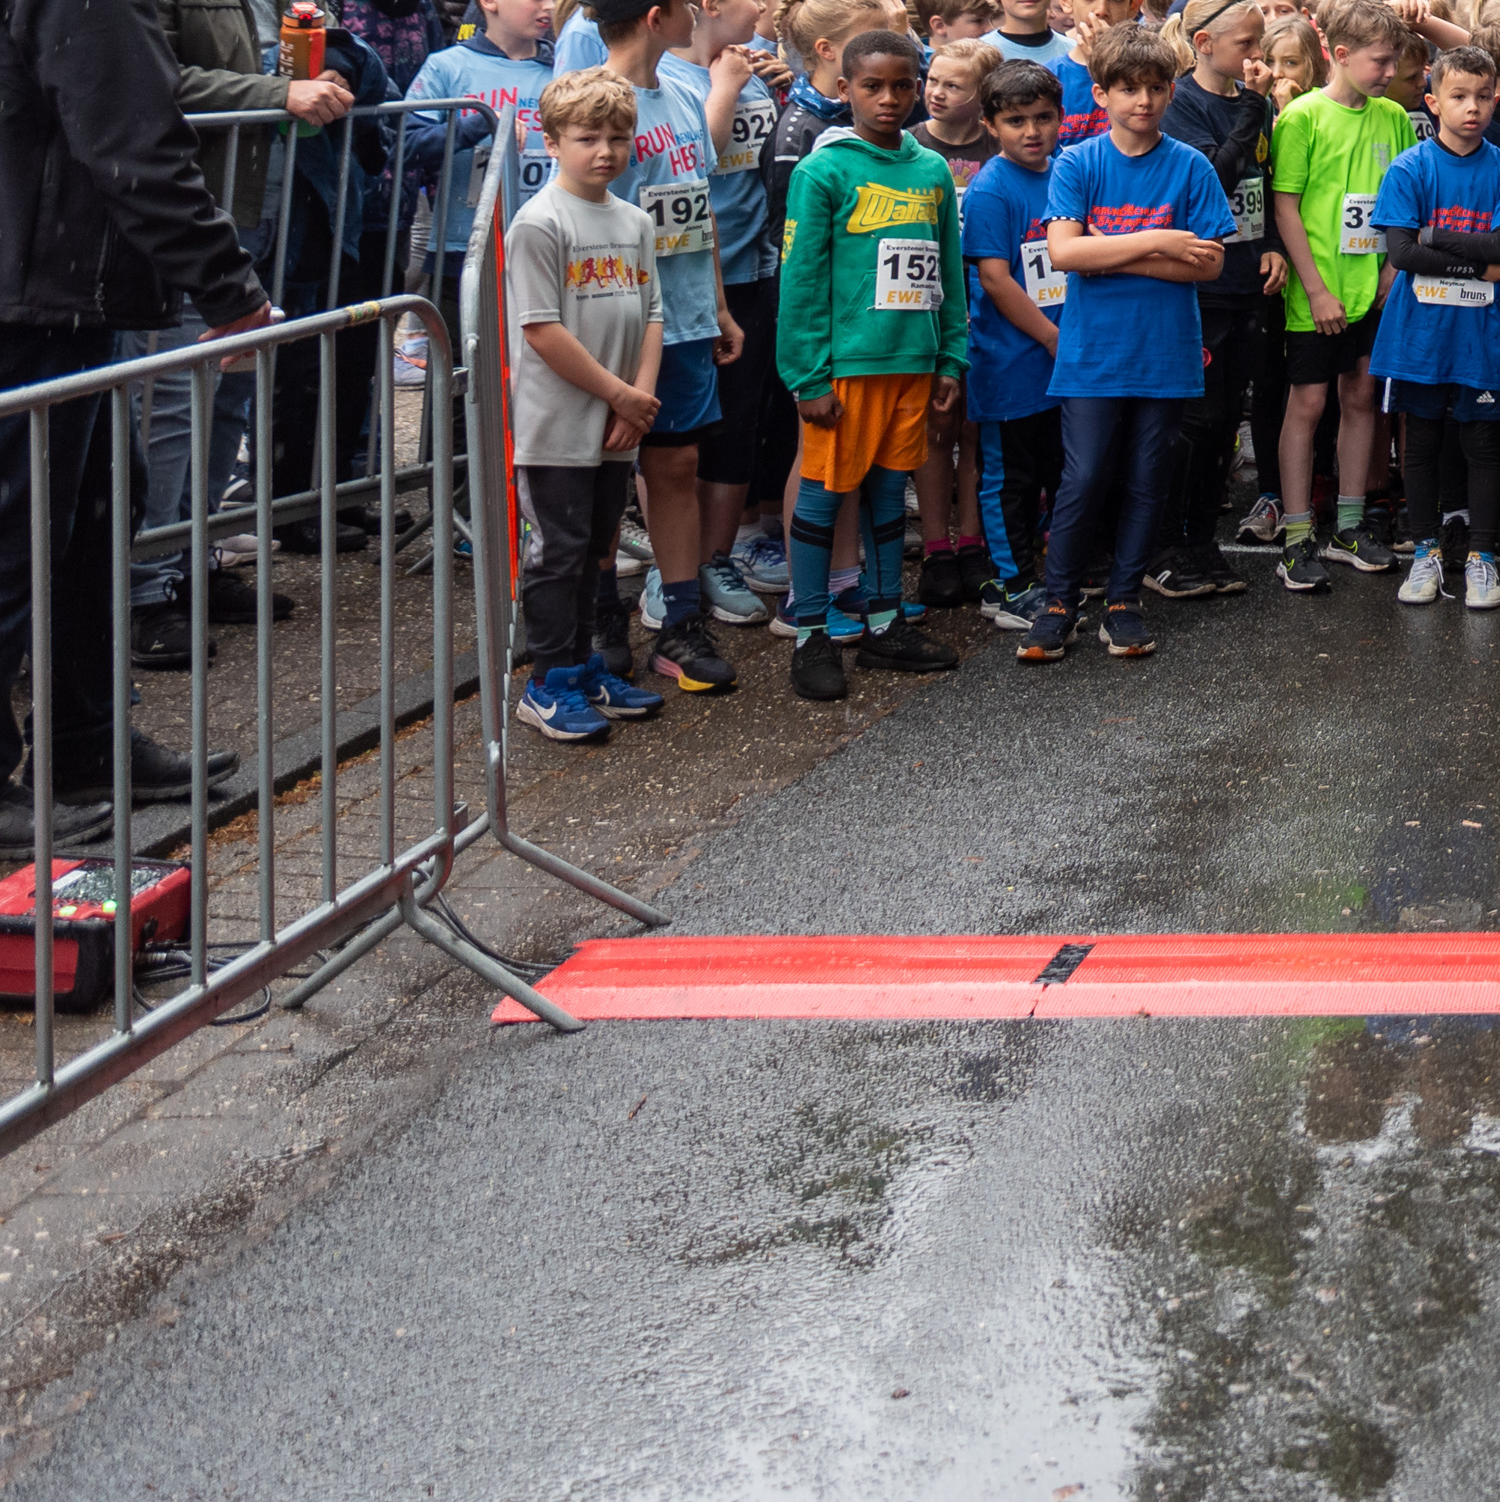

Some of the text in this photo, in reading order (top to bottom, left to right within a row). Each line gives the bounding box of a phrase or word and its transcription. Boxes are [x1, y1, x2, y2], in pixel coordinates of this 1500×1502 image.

[720, 150, 754, 169] EWE
[655, 234, 691, 251] EWE
[1348, 237, 1379, 249] EWE
[886, 290, 922, 304] EWE
[1415, 285, 1487, 301] EWE bruns
